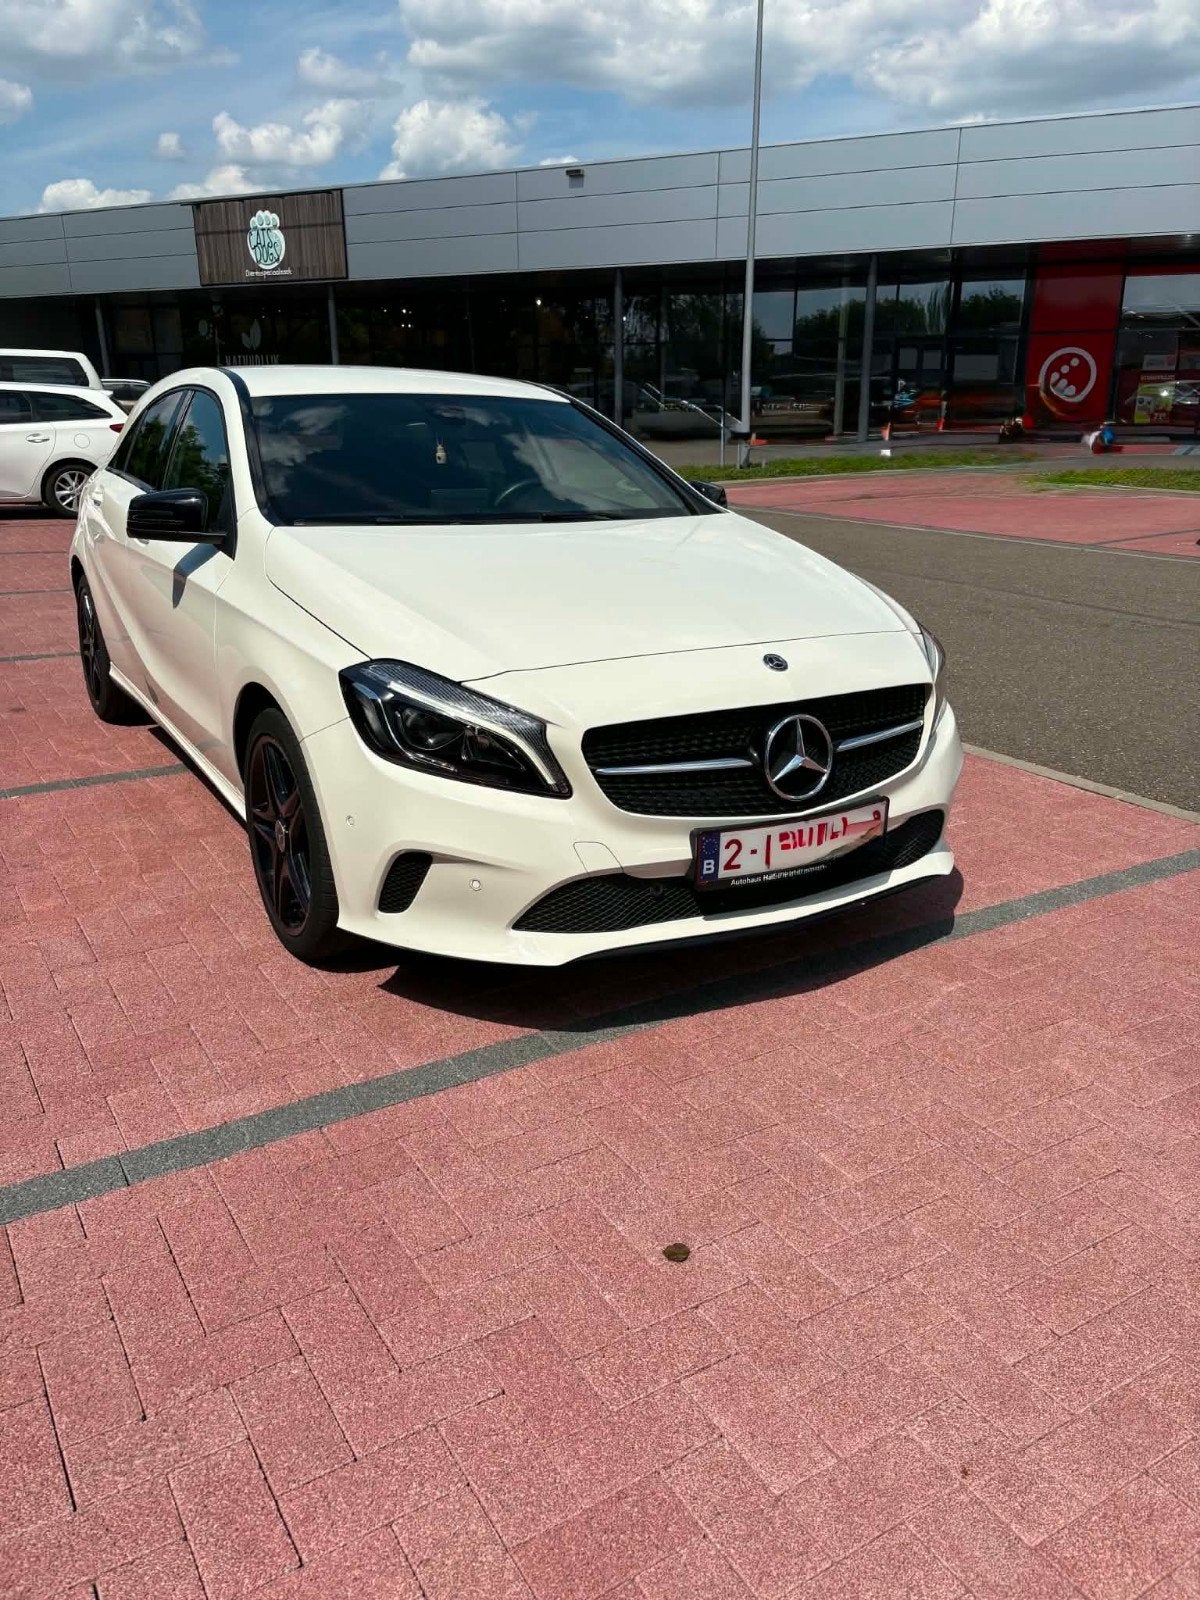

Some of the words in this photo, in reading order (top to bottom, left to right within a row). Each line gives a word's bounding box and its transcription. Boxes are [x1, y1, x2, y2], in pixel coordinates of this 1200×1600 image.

[249, 228, 273, 250] CATS
[702, 859, 715, 875] B
[730, 875, 763, 886] Autohaus
